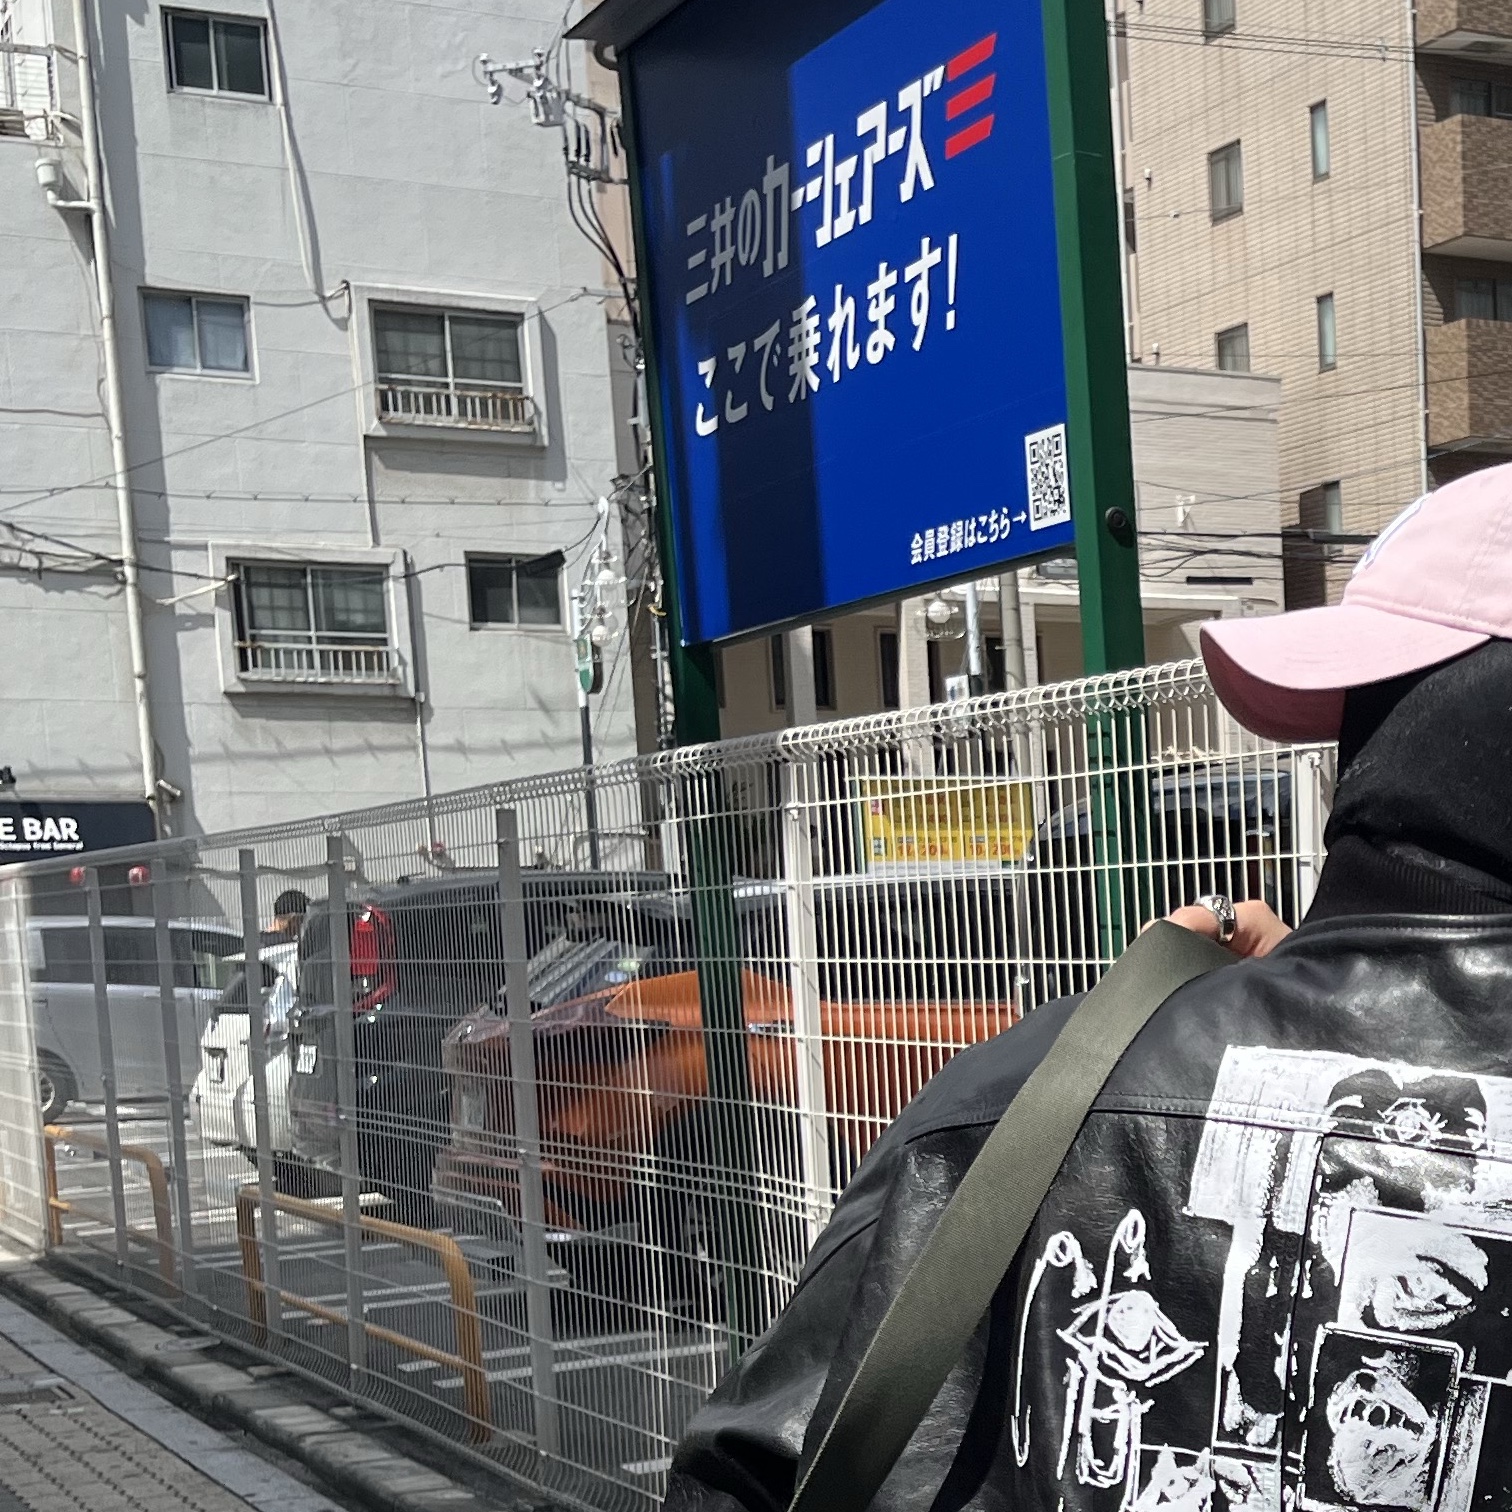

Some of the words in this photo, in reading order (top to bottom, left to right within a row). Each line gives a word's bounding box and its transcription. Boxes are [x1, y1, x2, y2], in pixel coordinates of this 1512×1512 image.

[695, 233, 958, 438] ここで乗れます！
[22, 817, 80, 842] BAR
